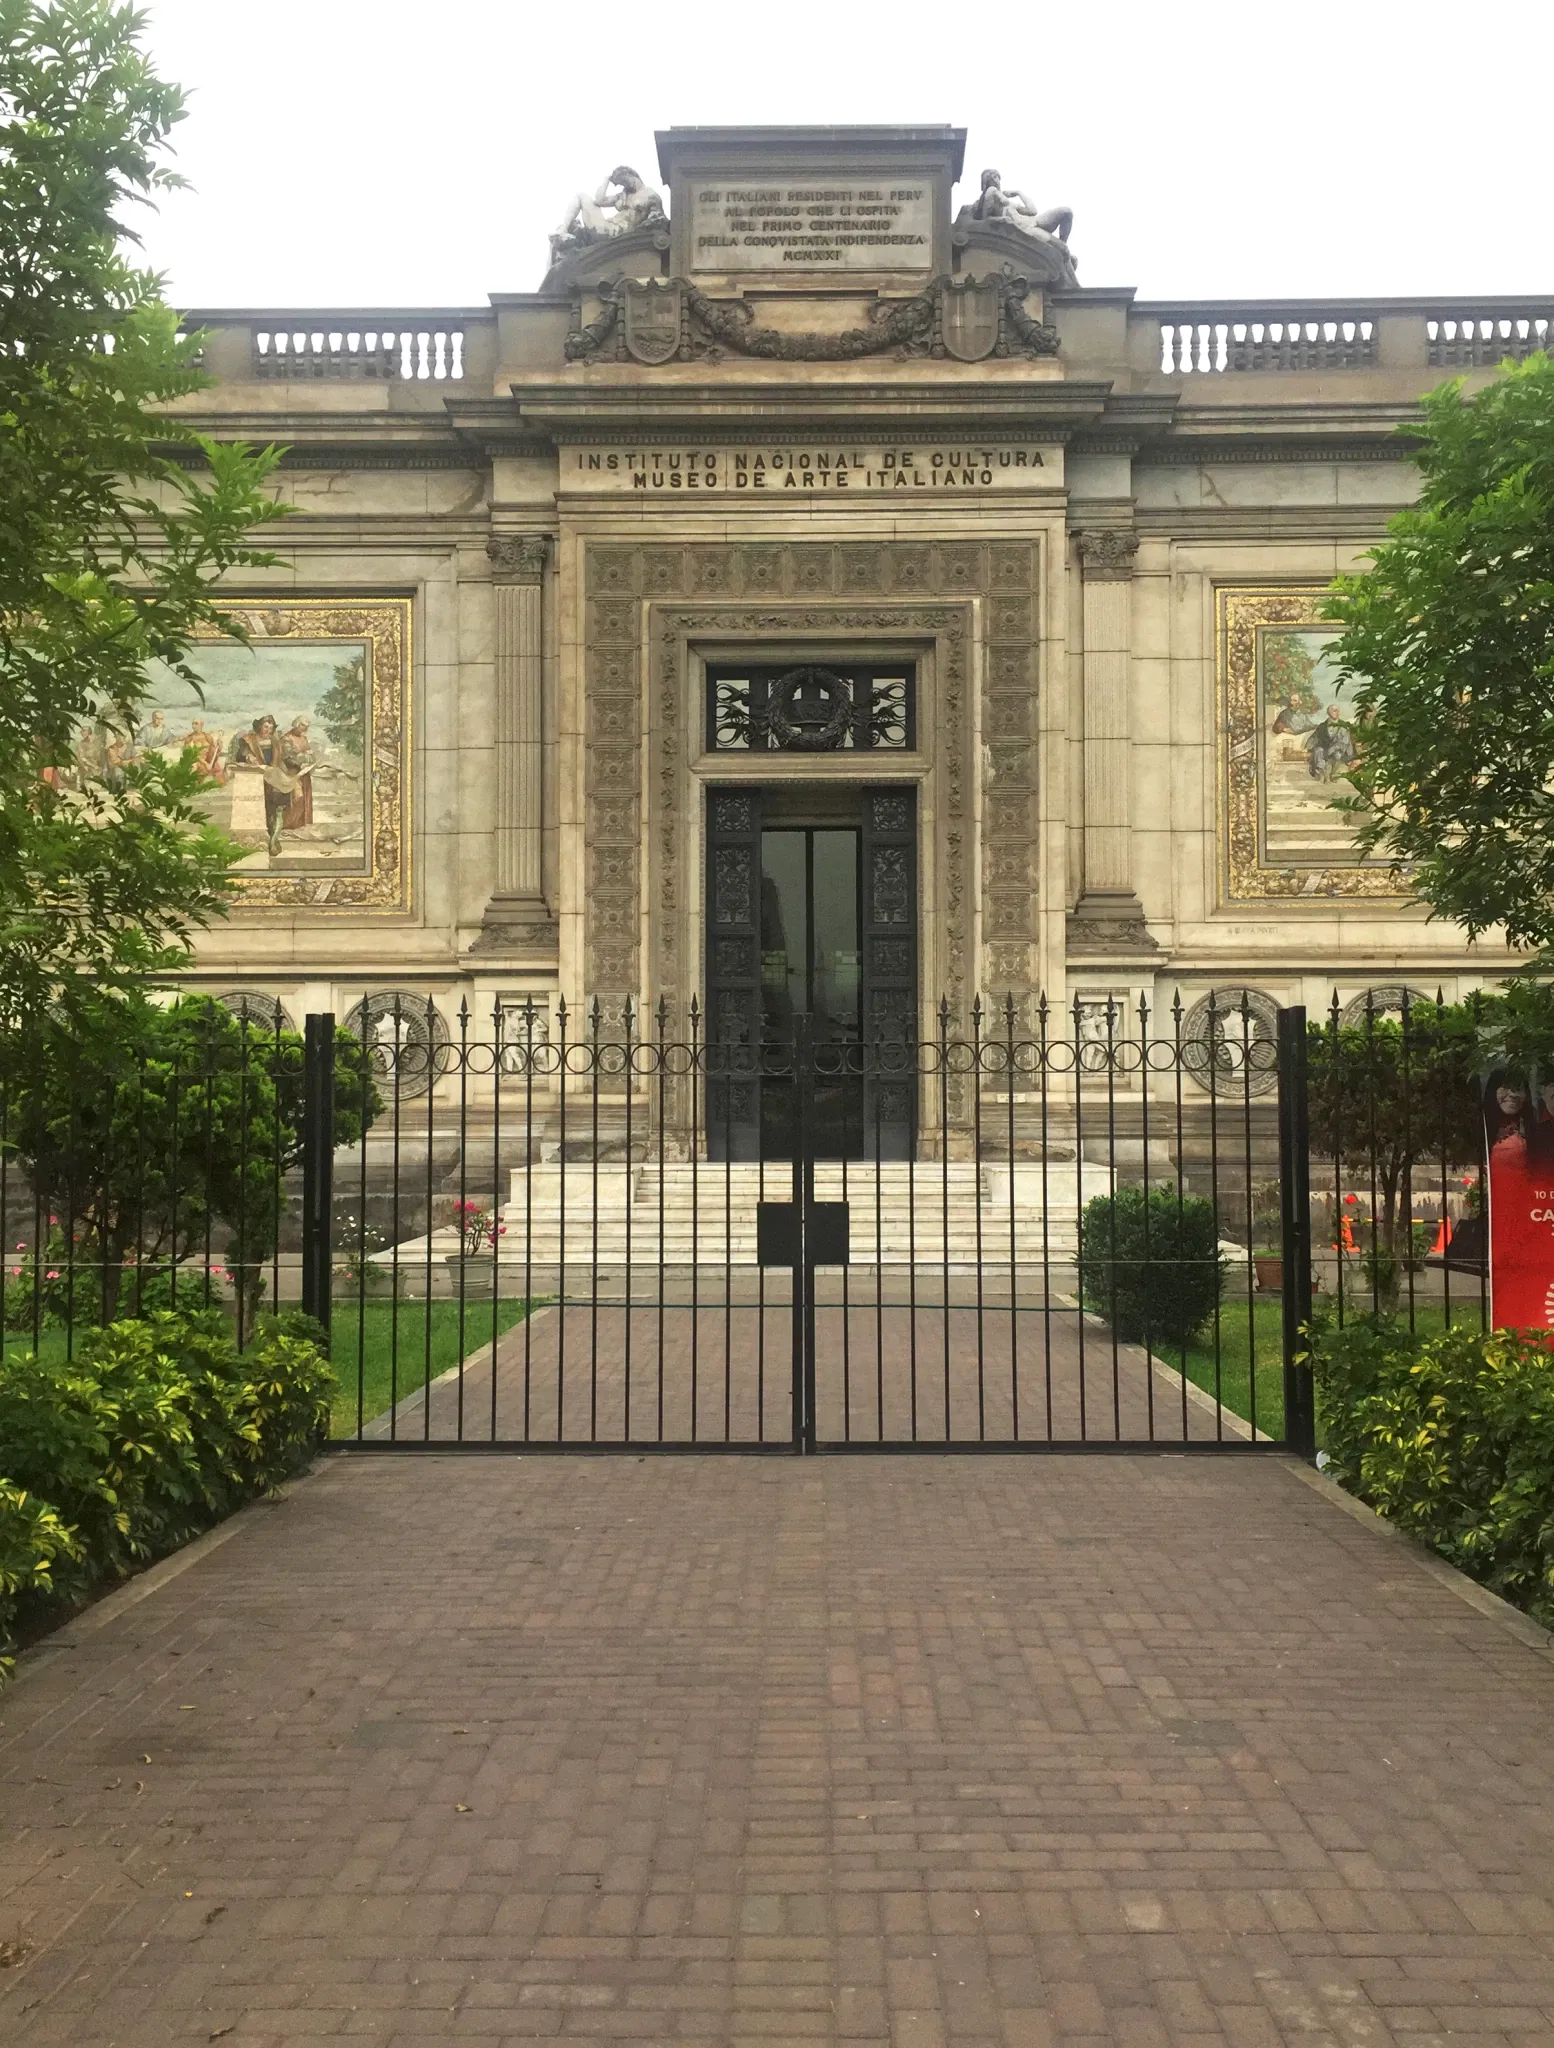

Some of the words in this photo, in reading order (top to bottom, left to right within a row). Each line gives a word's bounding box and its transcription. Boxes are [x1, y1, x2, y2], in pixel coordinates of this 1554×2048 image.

[726, 192, 781, 202] ITALIANI
[788, 192, 852, 201] RESIDENTI
[859, 191, 883, 201] NEL
[725, 207, 744, 217] AL
[750, 206, 800, 216] POPOLO
[807, 206, 833, 216] CHE
[840, 206, 850, 215] LI
[856, 206, 899, 216] OSPITA
[731, 222, 755, 231] NEL
[763, 221, 802, 231] PRIMO
[809, 221, 891, 231] CENTENARIO
[699, 237, 738, 247] DELLA
[835, 235, 924, 245] INDIPENDENZA
[783, 251, 841, 261] MCMXXI
[578, 453, 719, 470] INSTITUTO
[735, 452, 865, 469] NACIONAL
[884, 452, 915, 469] DE
[931, 451, 1045, 468] CULTURA
[634, 472, 719, 488] MUSEO
[736, 471, 766, 487] DE
[784, 471, 849, 487] ARTE
[866, 470, 994, 486] ITALIANO
[1534, 1190, 1547, 1200] 10
